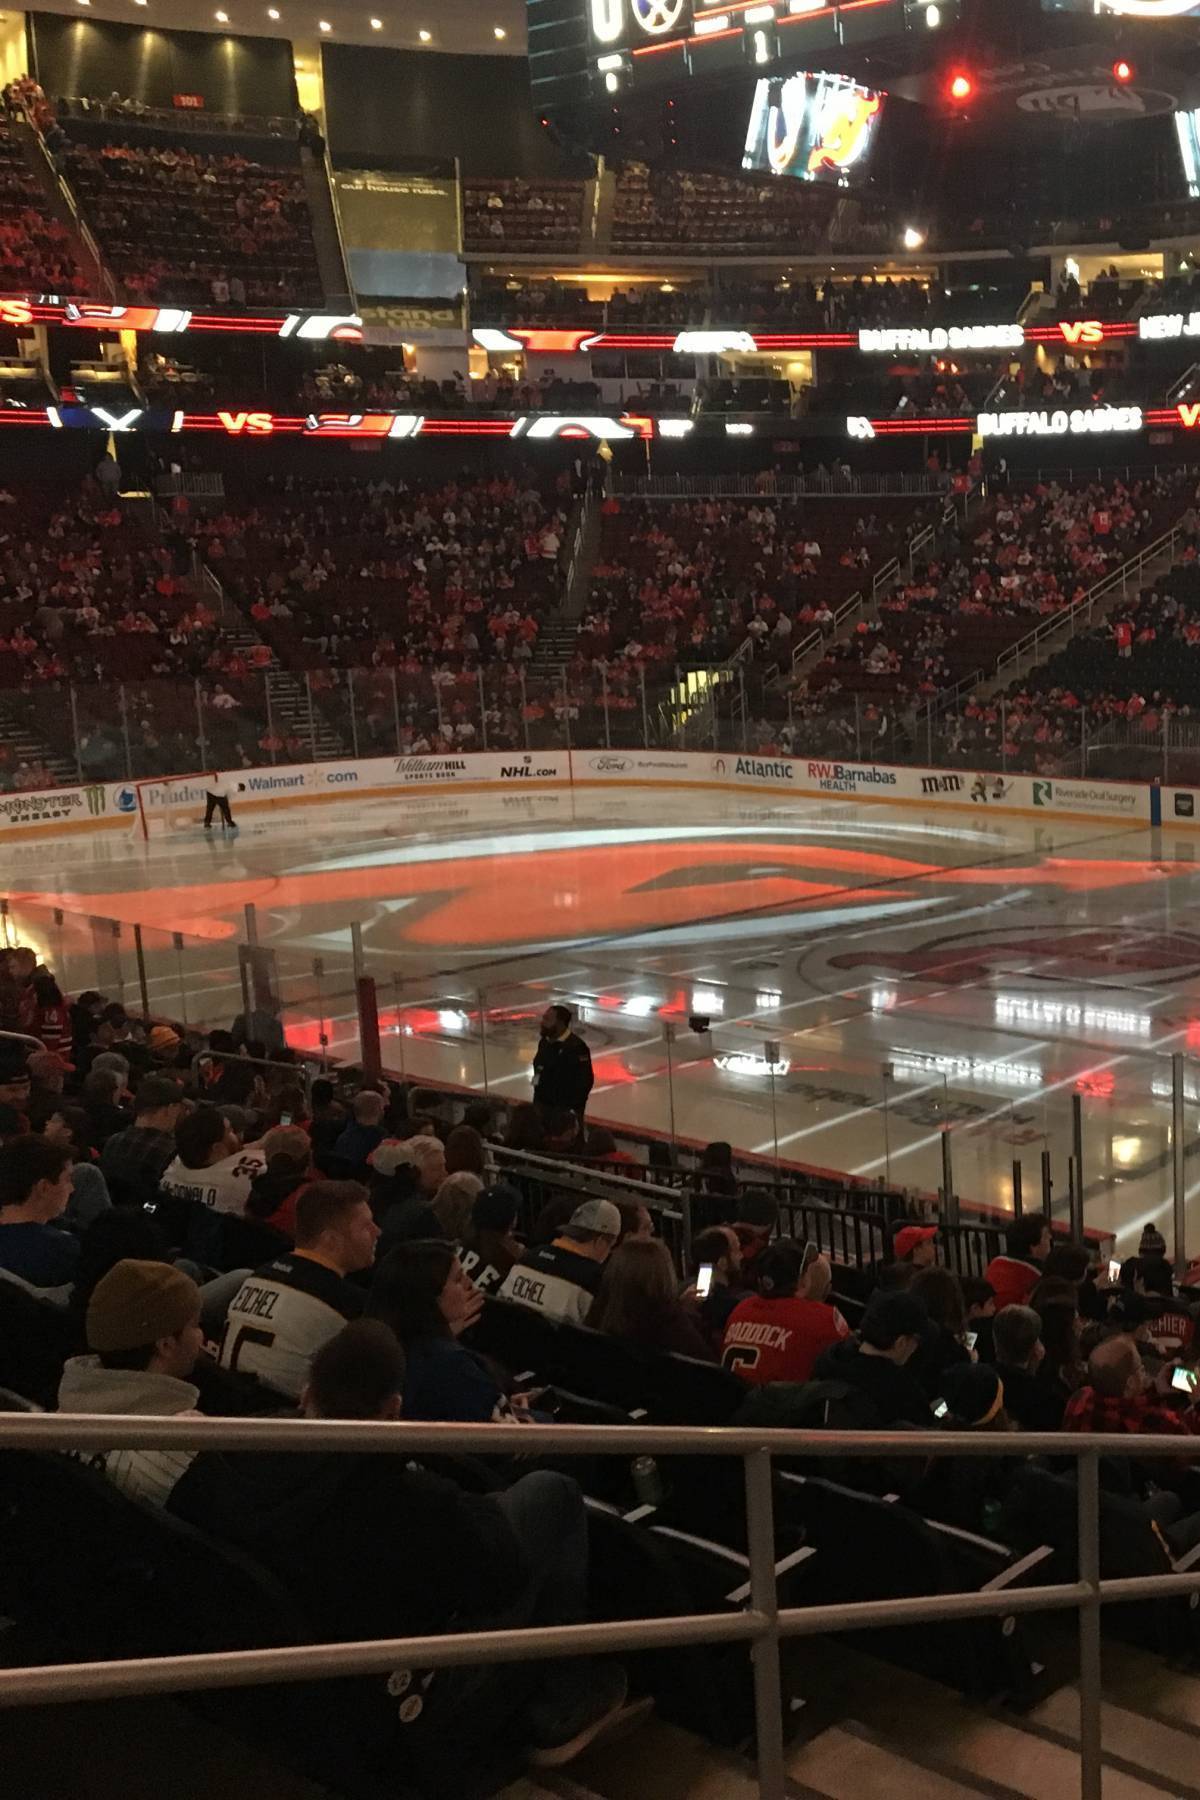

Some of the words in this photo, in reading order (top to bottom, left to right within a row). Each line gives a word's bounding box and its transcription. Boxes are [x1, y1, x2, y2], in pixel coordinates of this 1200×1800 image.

[0, 301, 33, 324] S
[859, 327, 949, 351] BUFFALO
[949, 324, 1025, 349] SABRES
[1059, 321, 1104, 343] VS
[1138, 314, 1184, 340] NEW
[217, 411, 275, 434] VS
[977, 411, 1069, 436] BUFFALO
[1069, 406, 1143, 433] SABRES
[735, 757, 794, 779] Atlantic
[248, 773, 305, 790] Walmart
[820, 779, 857, 792] HEALTH
